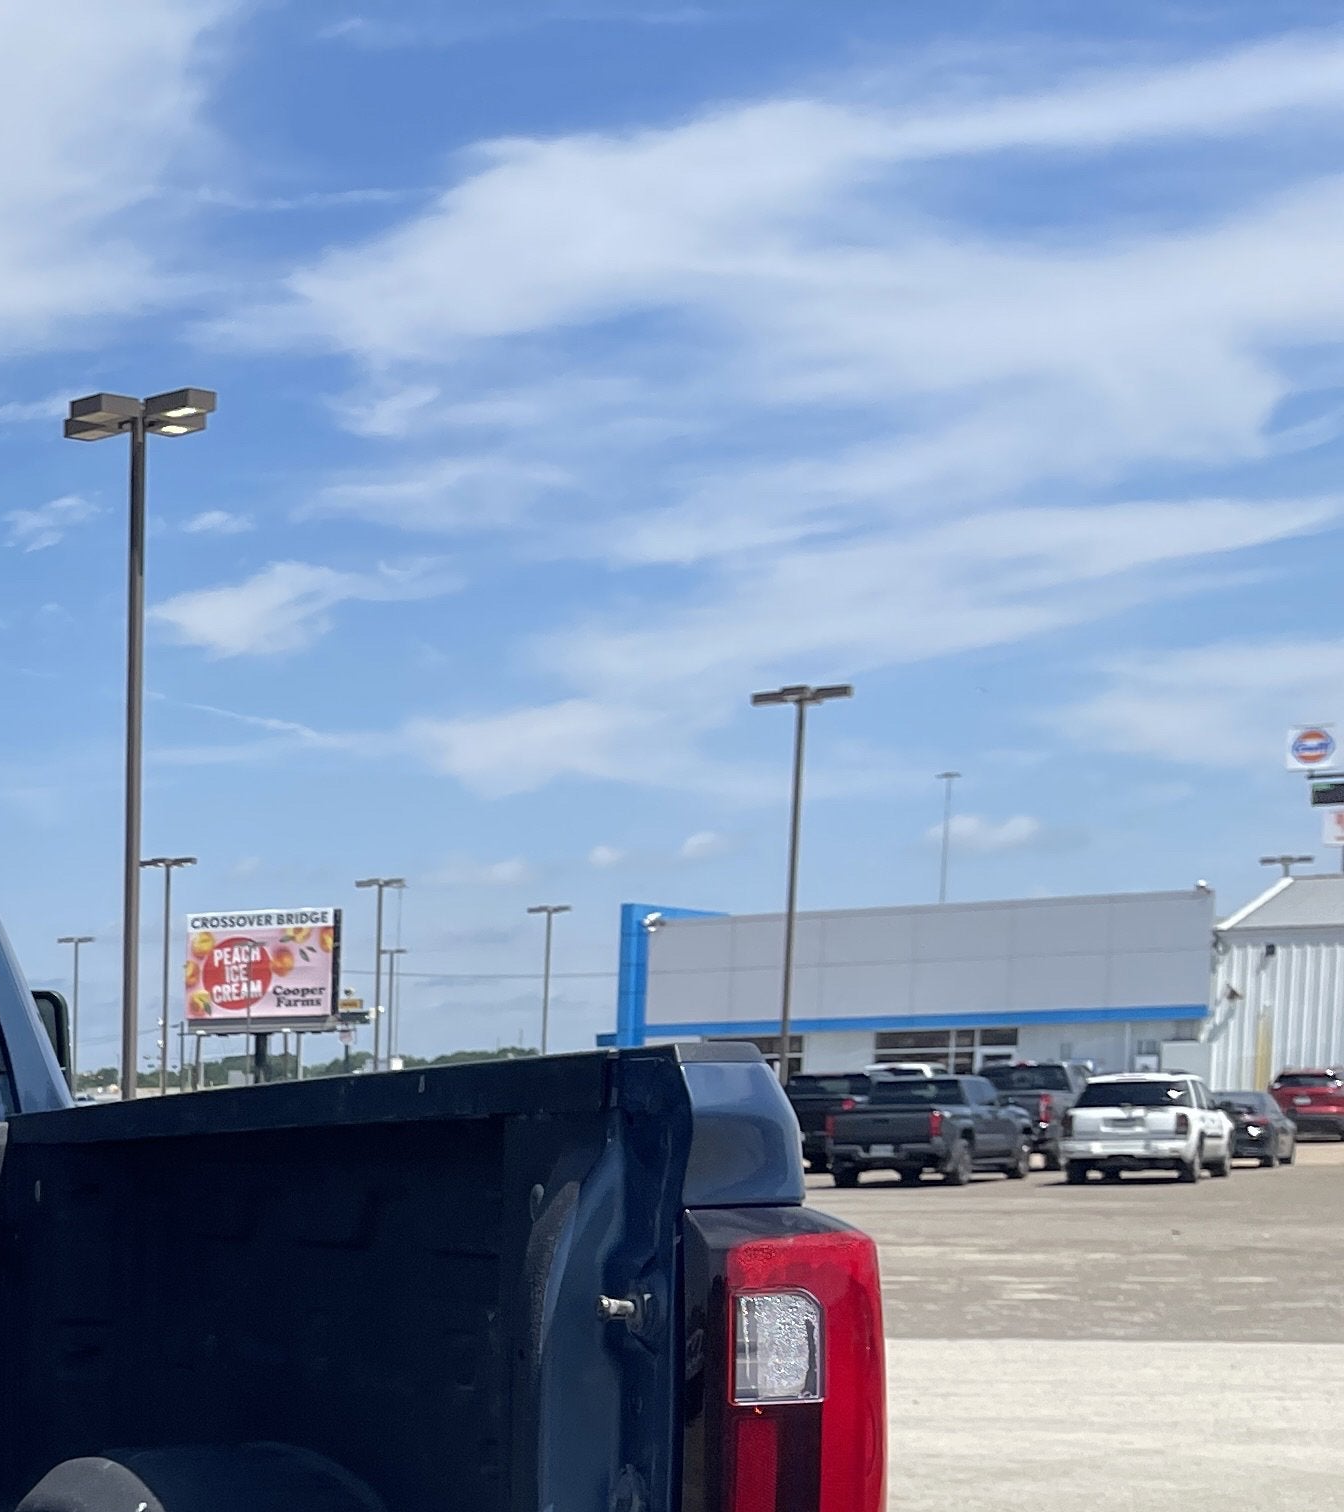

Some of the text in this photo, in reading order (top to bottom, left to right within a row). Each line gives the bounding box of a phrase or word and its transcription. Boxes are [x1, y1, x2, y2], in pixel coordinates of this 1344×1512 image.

[190, 911, 329, 929] CROSSOVER BRIDGE
[213, 946, 261, 967] PEACH
[224, 964, 249, 983] ICE
[212, 979, 263, 1004] CREAM
[272, 985, 326, 999] Cooper
[276, 996, 322, 1008] Farms
